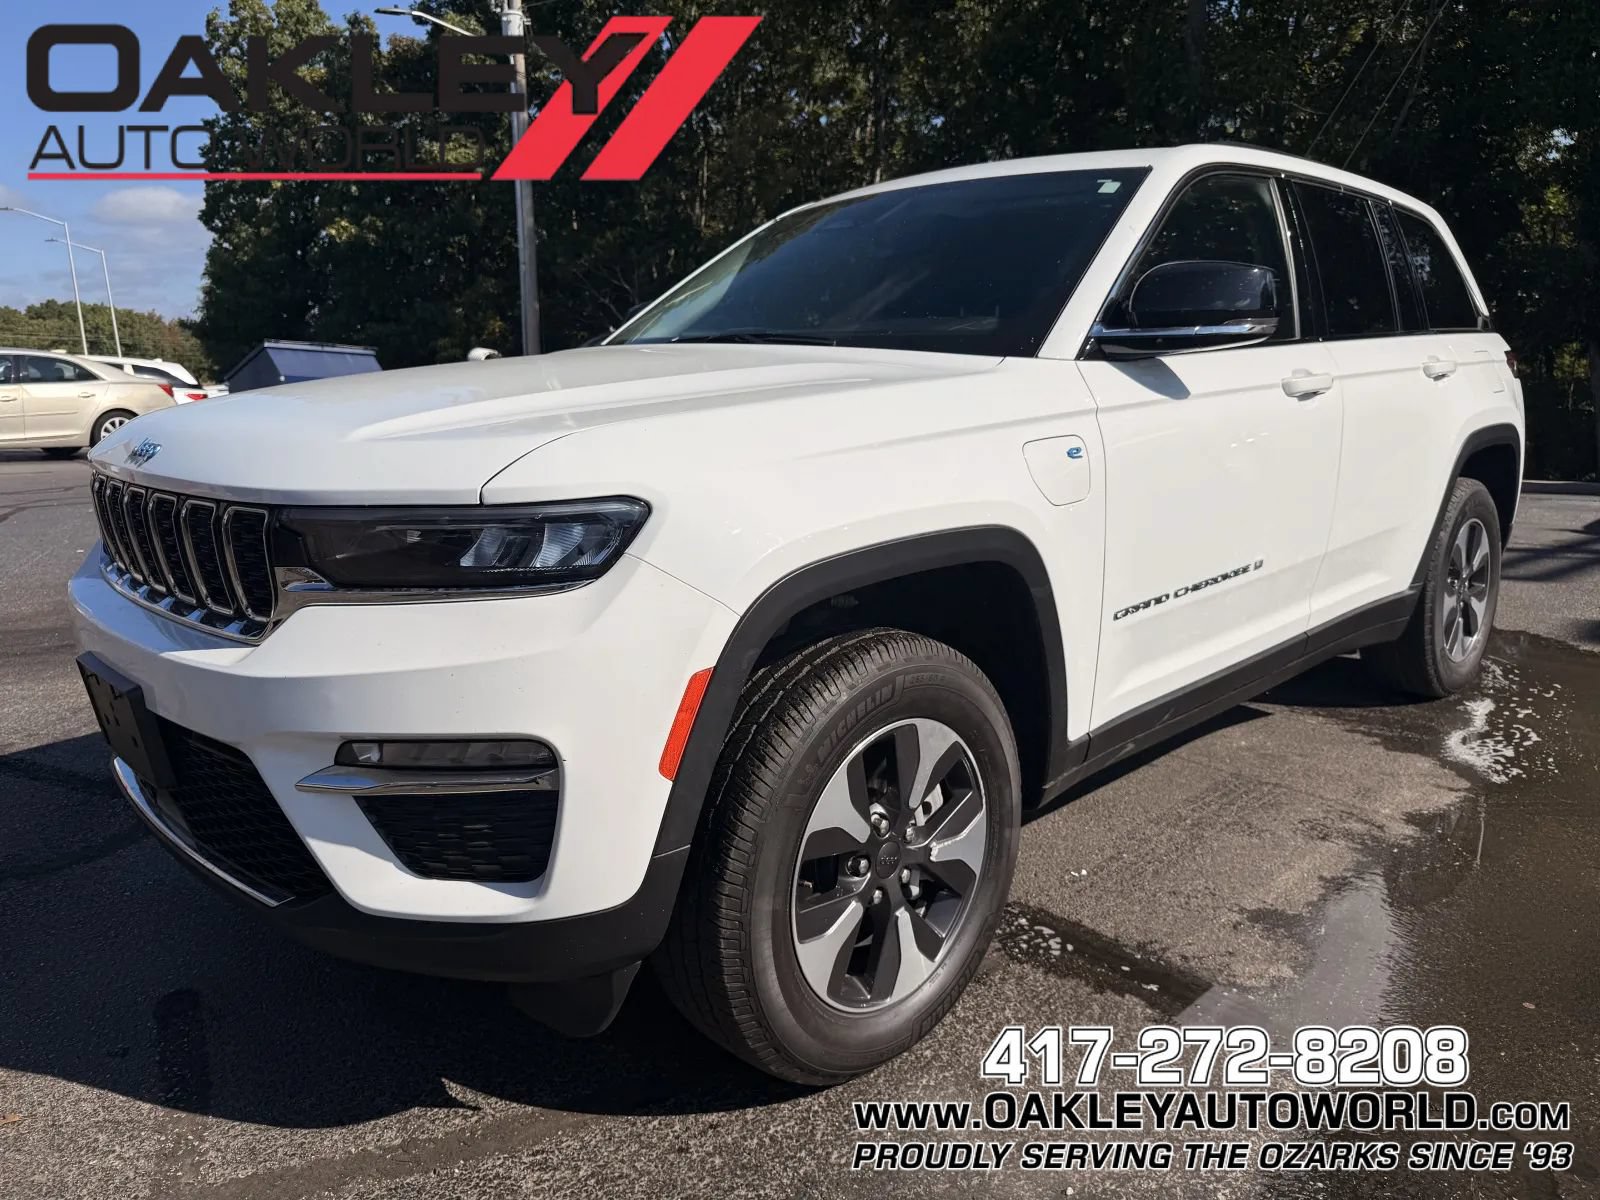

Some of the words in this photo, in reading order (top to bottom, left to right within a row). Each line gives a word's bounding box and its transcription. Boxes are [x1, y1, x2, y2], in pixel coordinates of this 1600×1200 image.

[1113, 593, 1170, 621] GRAND
[1173, 563, 1252, 598] CHEROKEE
[816, 683, 894, 763] MICHELIN
